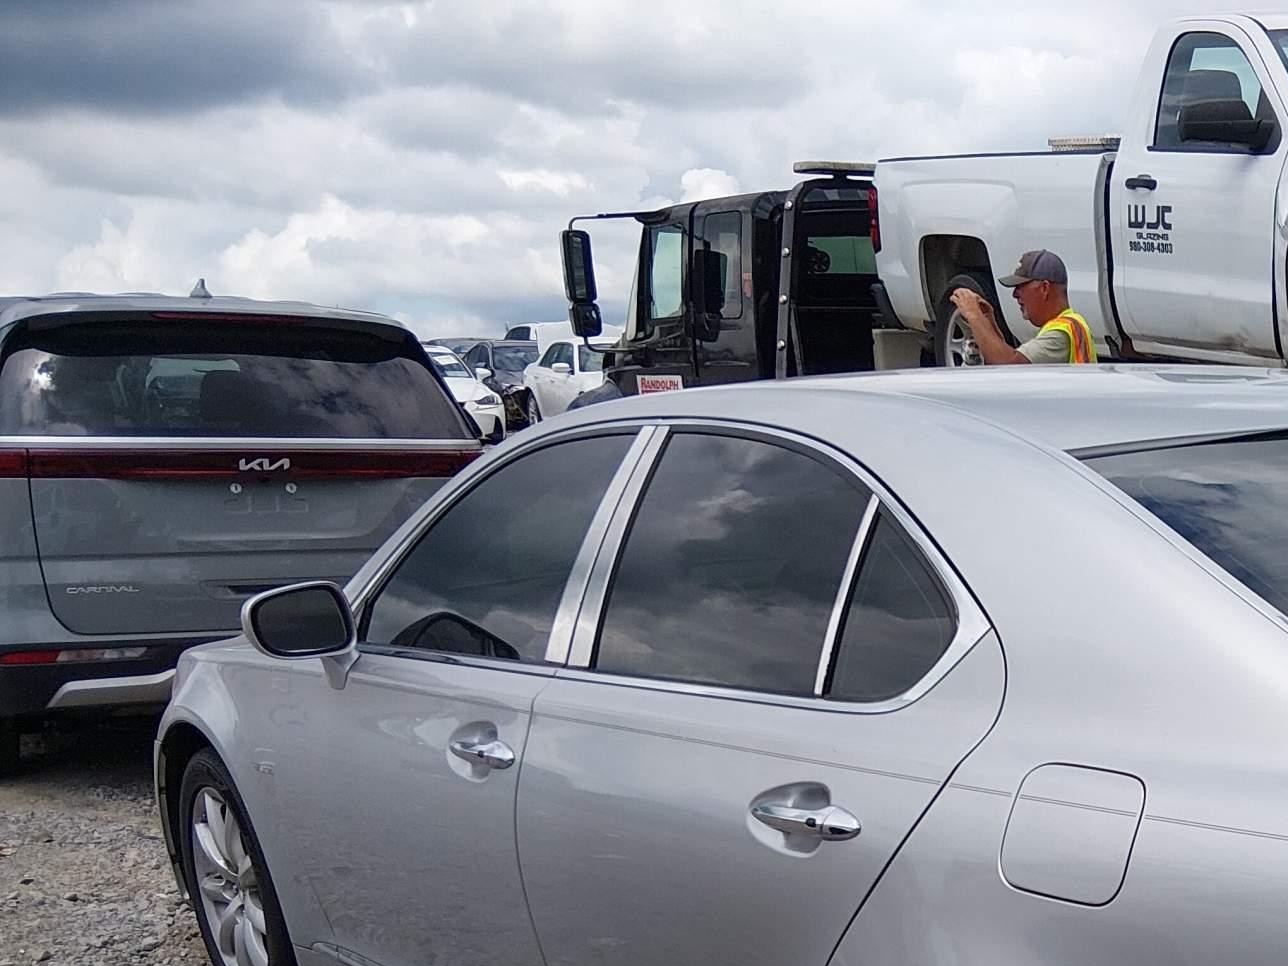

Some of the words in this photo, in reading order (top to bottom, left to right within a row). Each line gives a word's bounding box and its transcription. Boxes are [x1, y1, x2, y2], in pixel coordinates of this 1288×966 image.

[1128, 204, 1172, 230] WJC
[640, 377, 679, 390] RANDOLPH
[239, 457, 290, 471] KIA
